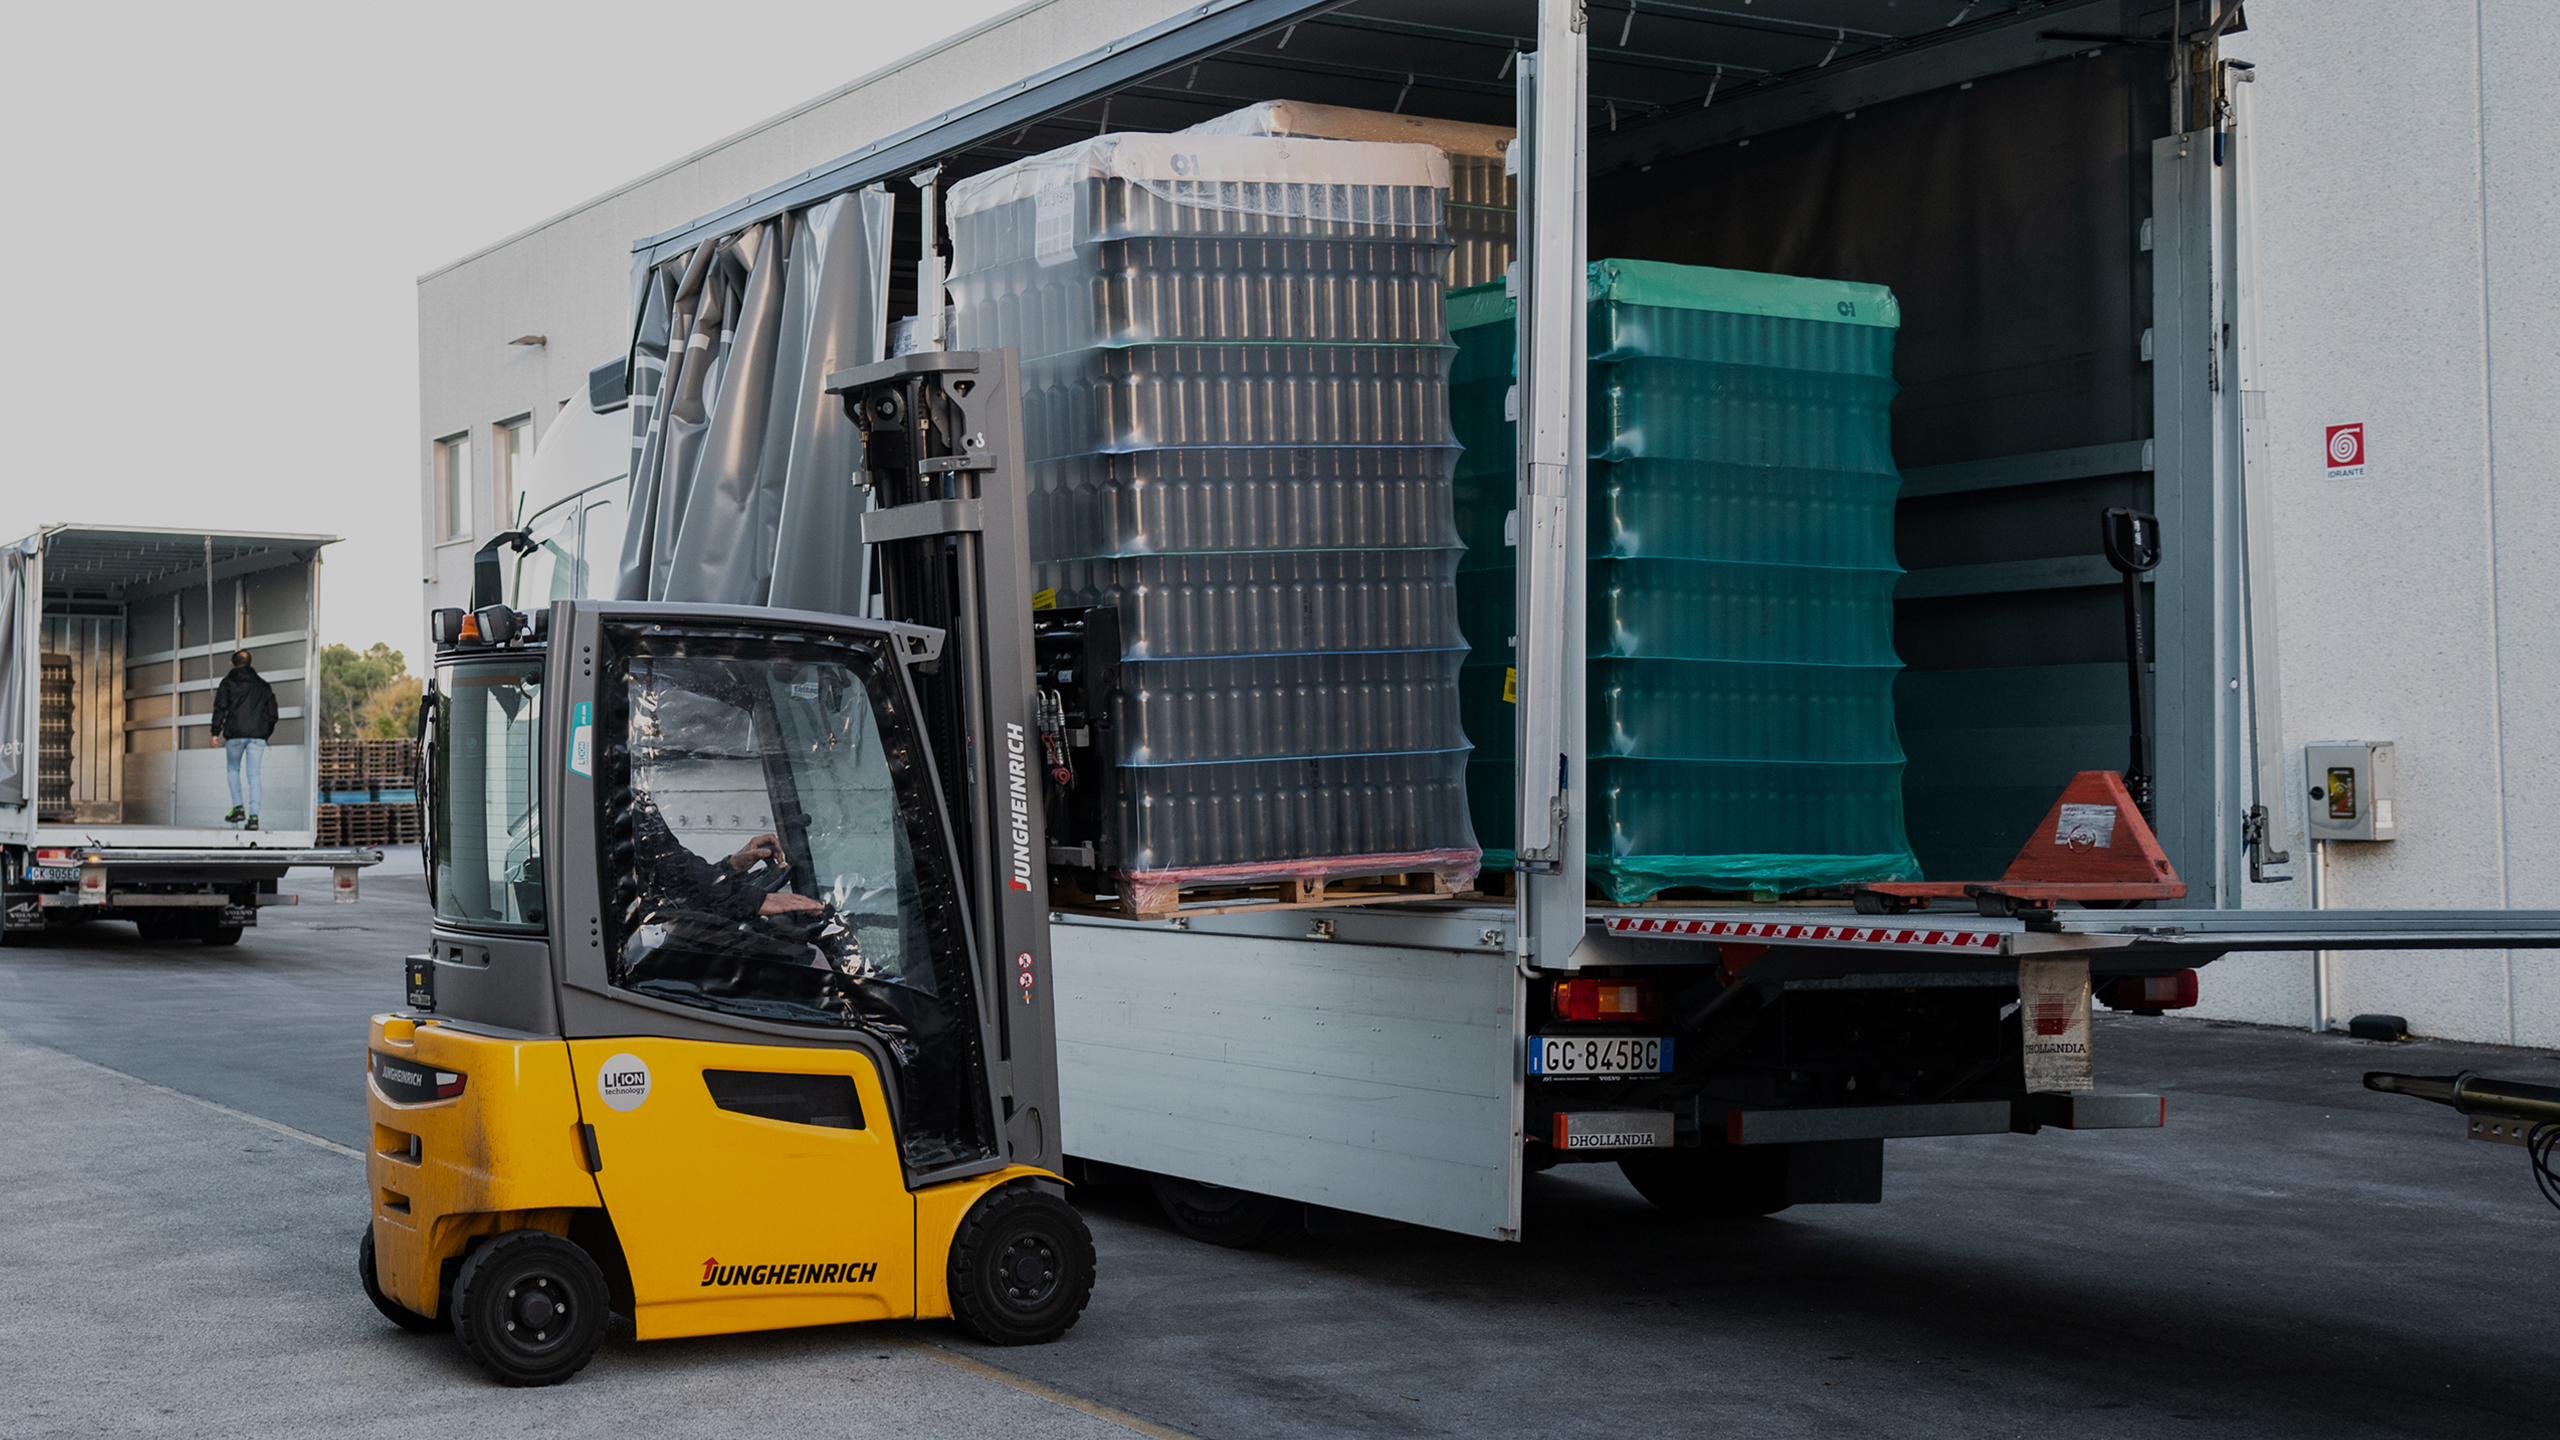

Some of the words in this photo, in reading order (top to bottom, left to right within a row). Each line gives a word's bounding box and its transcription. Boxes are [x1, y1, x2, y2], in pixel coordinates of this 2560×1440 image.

[2327, 468, 2365, 478] IDRANTE
[1007, 722, 1032, 892] JUNGHEINRICH
[382, 1065, 422, 1087] JUNGHEINRICH
[605, 1087, 645, 1095] technology
[1569, 1133, 1654, 1147] DHOLLANDIA
[701, 1260, 878, 1287] JUNGHEINRICH
